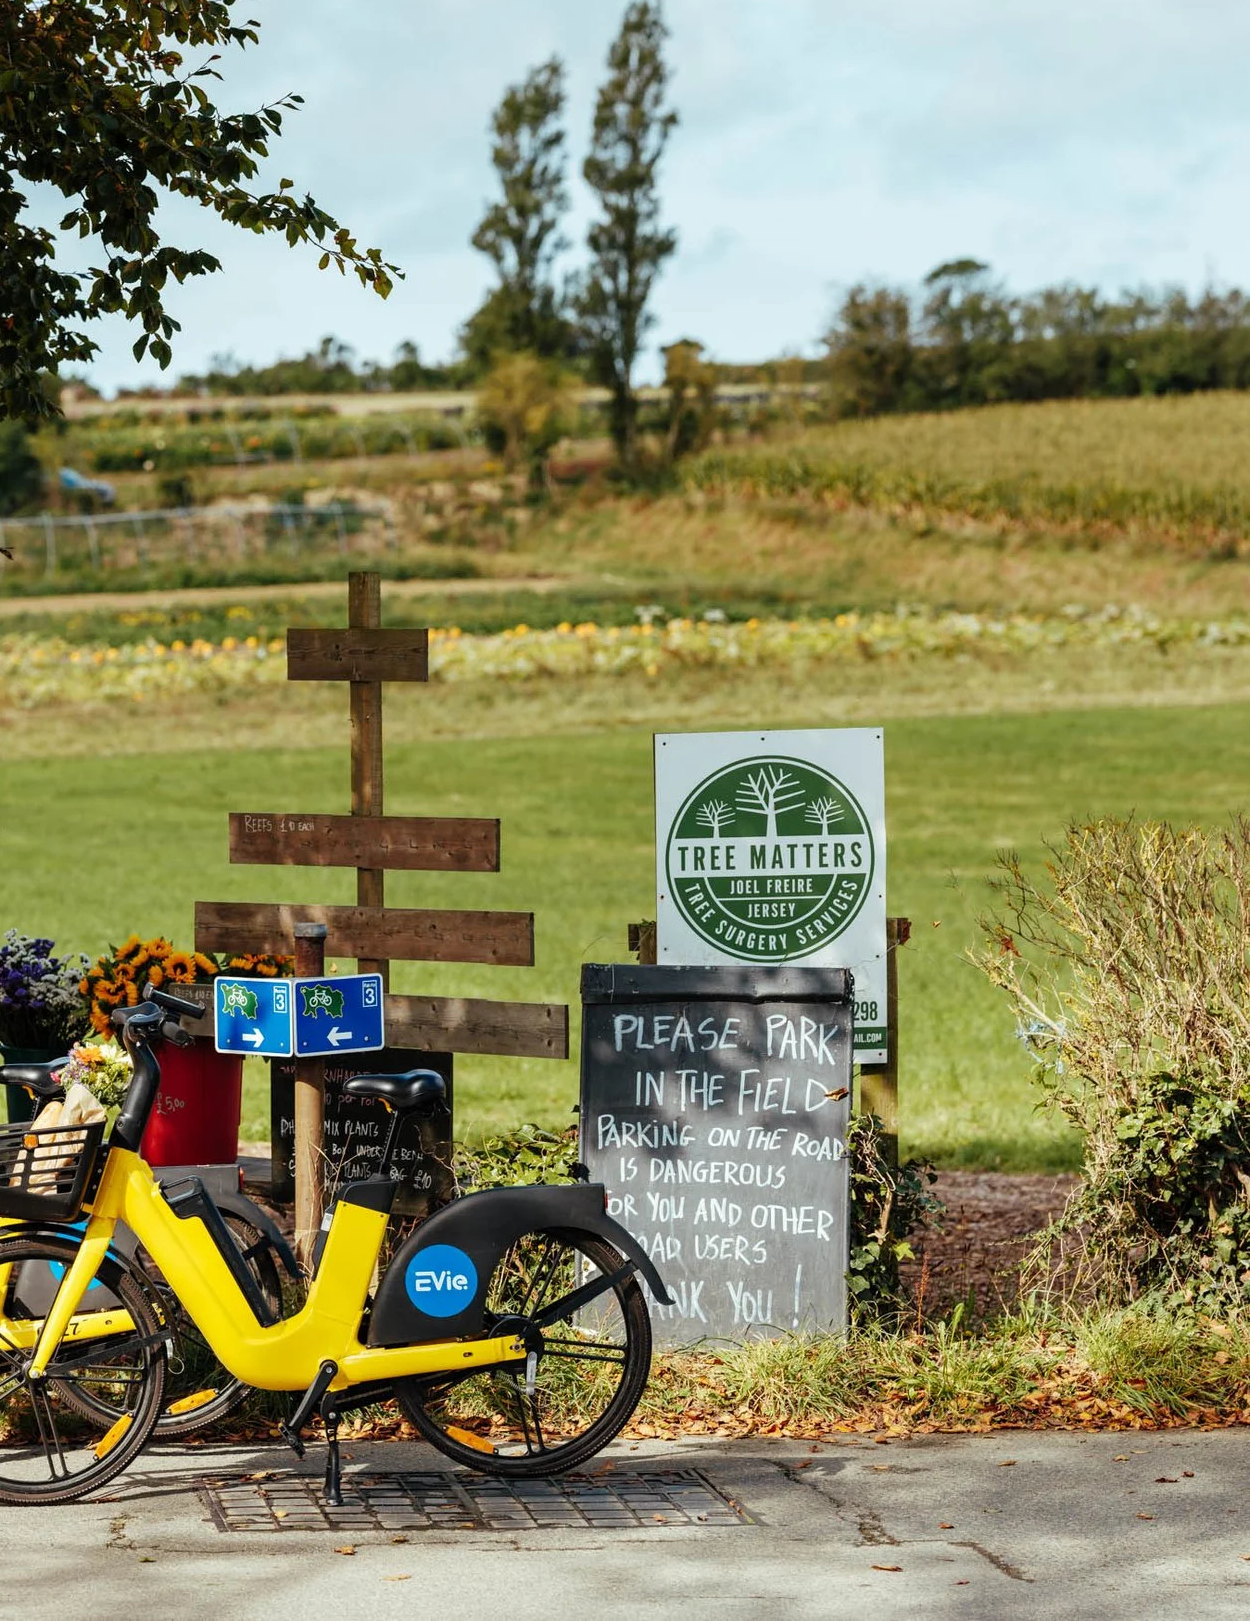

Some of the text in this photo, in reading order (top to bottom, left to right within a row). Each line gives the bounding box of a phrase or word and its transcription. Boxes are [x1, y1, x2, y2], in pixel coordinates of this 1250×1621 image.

[298, 821, 315, 832] EACH
[677, 841, 862, 871] TREE MATTERS
[730, 878, 813, 895] JOEL FREIRE
[685, 879, 858, 951] TREE SURGERY SERVICES
[748, 903, 796, 918] JERSEY
[276, 994, 285, 1010] 3
[365, 988, 375, 1004] 3
[613, 1013, 838, 1066] PLEASE PARK
[853, 1033, 882, 1043] AIL.COM
[636, 1069, 829, 1115] IN THE FIELD
[345, 1120, 379, 1137] PLANTS
[708, 1127, 741, 1148] ON
[746, 1126, 788, 1151] THE
[791, 1132, 844, 1162] ROAD
[620, 1157, 786, 1190] IS DANGEROUS
[607, 1189, 834, 1242] OR YOU AND OTHER
[634, 1232, 767, 1266] OAD USERS
[645, 1280, 707, 1323] ANK
[726, 1281, 773, 1323] YOU
